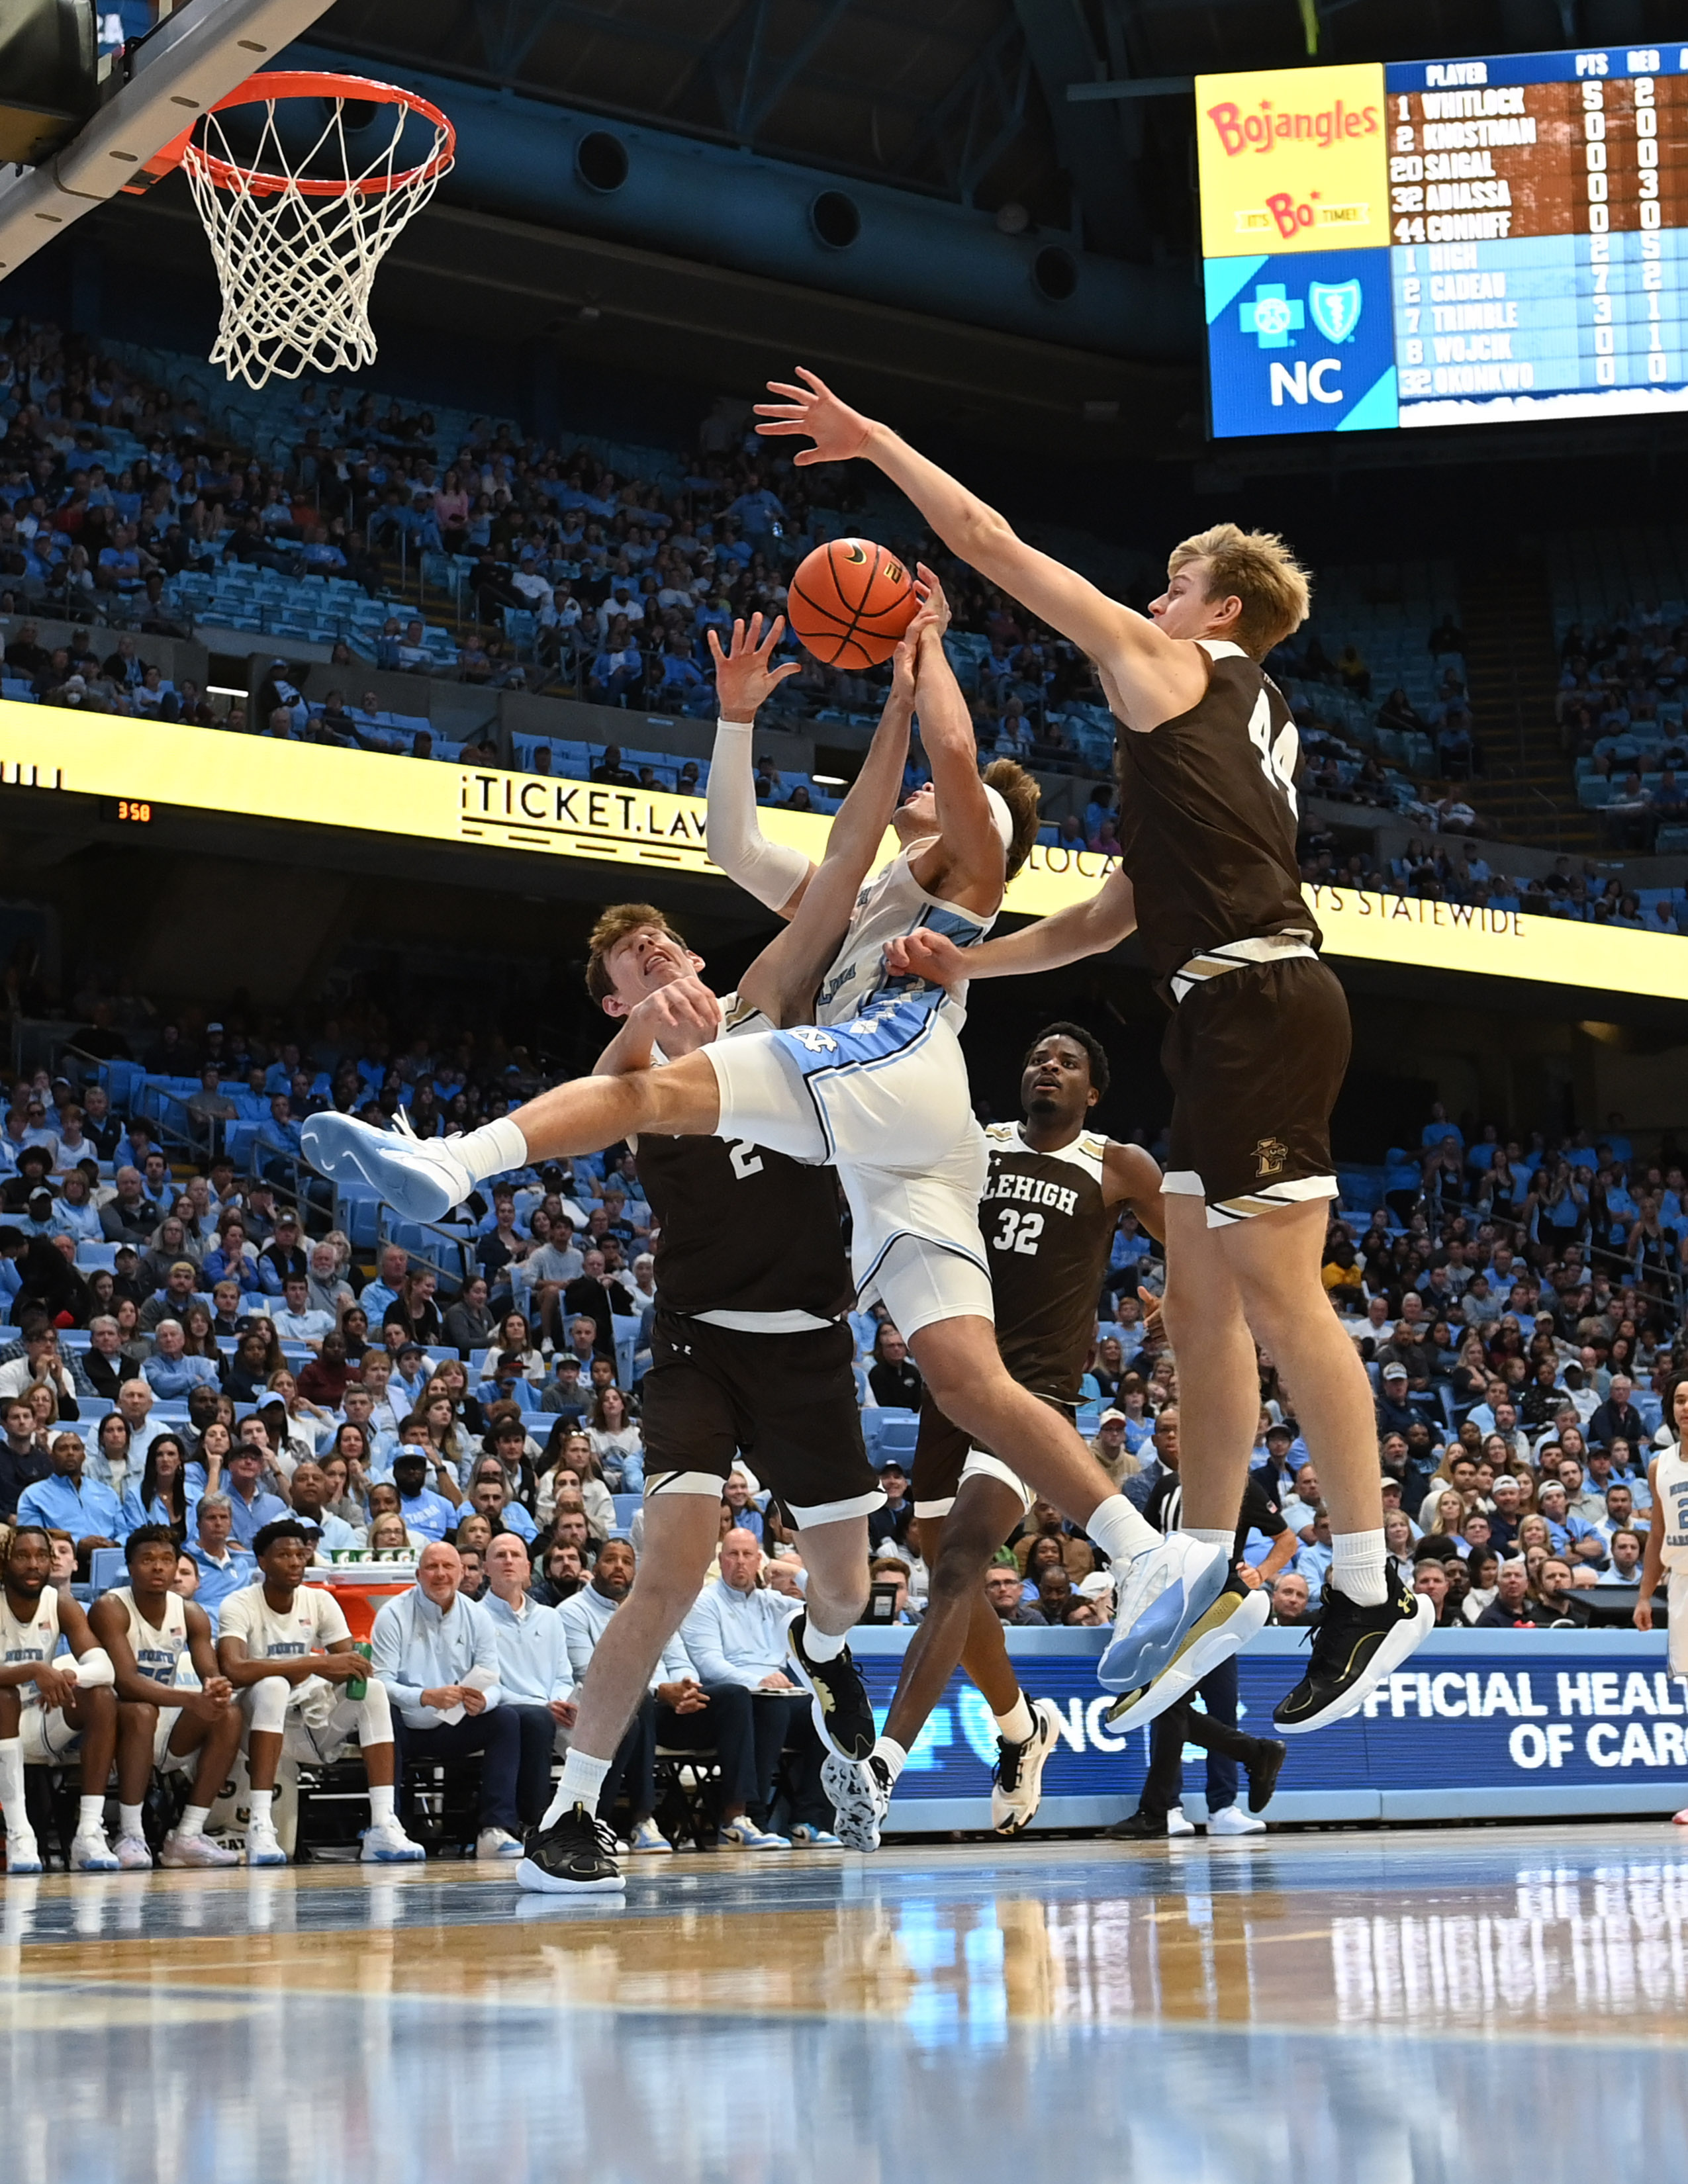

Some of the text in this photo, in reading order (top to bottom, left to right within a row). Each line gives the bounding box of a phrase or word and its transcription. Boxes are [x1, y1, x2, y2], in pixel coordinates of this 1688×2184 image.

[1426, 62, 1487, 87] PLAYER
[1575, 53, 1609, 77] PTS
[1397, 77, 1655, 120] 1 WHITLOCK 5 2
[1207, 99, 1379, 156] Bojangles
[1396, 126, 1415, 152] 2
[1585, 111, 1605, 141] 0
[1636, 107, 1657, 138] 0
[1390, 156, 1423, 182] 20
[1586, 142, 1607, 171] 0
[1637, 138, 1658, 168] 0
[1391, 185, 1423, 212] 32
[1587, 172, 1608, 203] 0
[1638, 169, 1659, 199] 3
[1247, 214, 1269, 228] IT'S
[1323, 208, 1356, 222] TIME!
[1394, 217, 1425, 243] 44
[1589, 203, 1609, 233] 0
[1640, 200, 1661, 230] 0
[1405, 248, 1416, 273] 1
[1590, 234, 1609, 263] 2
[1640, 230, 1661, 259] 5
[1403, 261, 1662, 302] 2 CADEAU 7 2
[1405, 292, 1661, 333] 7 TRIMBLE 3 1
[1406, 322, 1662, 364] 8 WOJCIK 0 1
[1270, 358, 1343, 406] NC
[1399, 368, 1432, 395] 32
[1596, 355, 1615, 385] 0
[1648, 352, 1667, 383] 0
[1030, 847, 1116, 878] LOCA
[982, 1174, 1078, 1216] LEHIGH
[993, 1208, 1045, 1255] 32
[1342, 1672, 1548, 1718] FFICIAL
[1509, 1722, 1688, 1768] OF CAR
